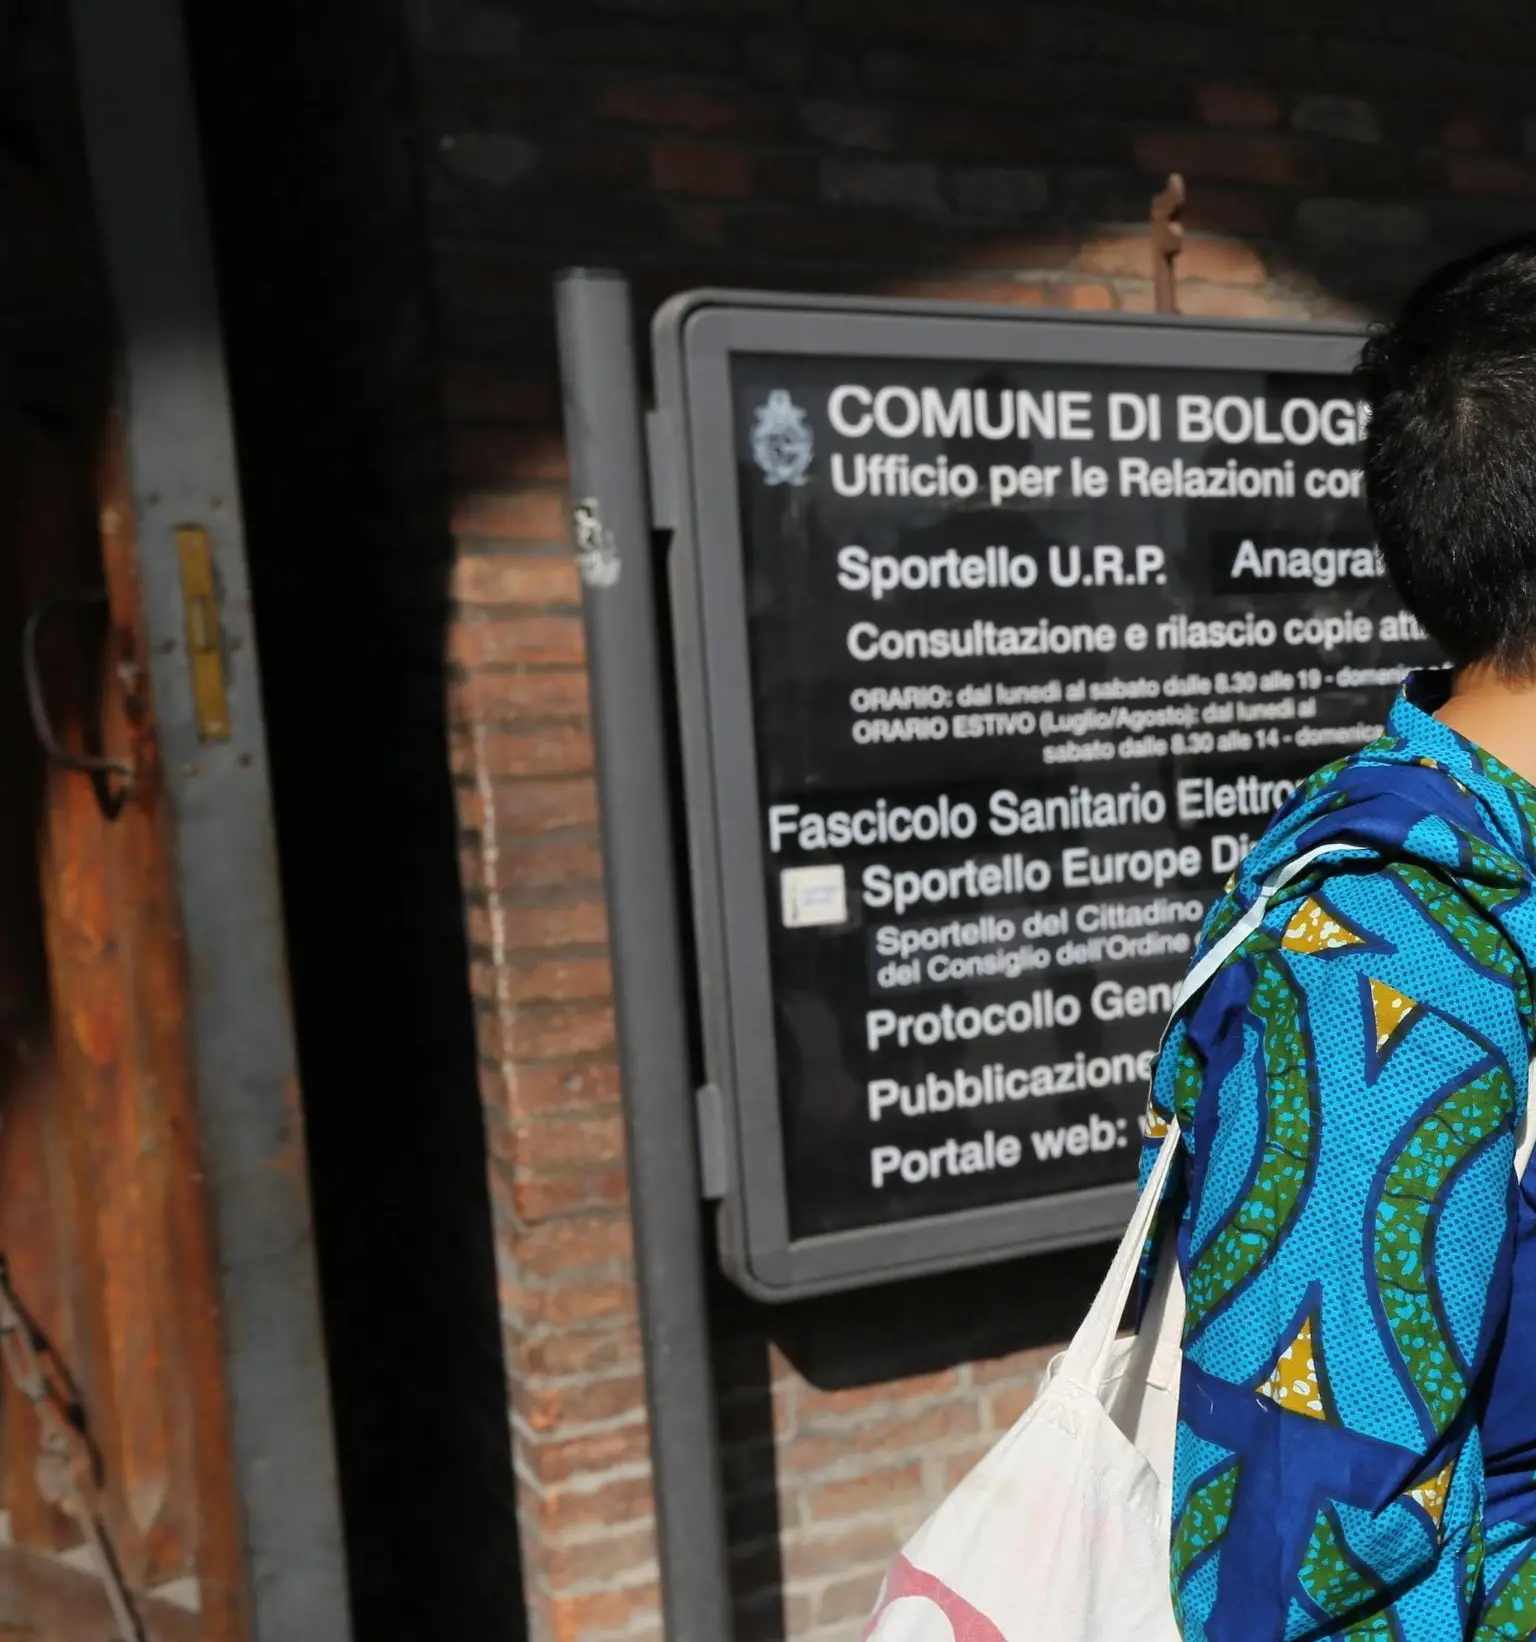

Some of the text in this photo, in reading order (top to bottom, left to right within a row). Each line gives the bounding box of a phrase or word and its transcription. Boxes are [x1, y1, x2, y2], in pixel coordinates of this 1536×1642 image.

[828, 386, 1092, 440] COMUNE
[1108, 394, 1158, 442] DI
[830, 455, 976, 497] Ufficio
[990, 462, 1060, 506] per
[1072, 456, 1106, 497] le
[1119, 459, 1294, 498] Relazioni
[837, 547, 1036, 598] Sportello
[1049, 546, 1166, 587] U.R.P.
[847, 609, 1429, 661] Consultazione e rilascio copie att
[850, 685, 952, 712] ORARIO:
[956, 683, 992, 707] dal
[1065, 678, 1085, 702] al
[1089, 677, 1160, 700] sabato
[1163, 674, 1212, 697] dalle
[1214, 671, 1257, 694] 8.30
[1259, 670, 1294, 692] alle
[852, 715, 949, 744] ORARIO
[951, 711, 1036, 738] ESTIVO
[1202, 701, 1234, 724] dal
[1297, 696, 1316, 718] al
[1042, 739, 1116, 764] sabato
[1118, 734, 1168, 759] dalle
[1170, 731, 1214, 755] 8.30
[1216, 729, 1253, 752] alle
[1254, 727, 1279, 748] 14
[769, 775, 1304, 852] Fascicolo Sanitario Elettro
[863, 854, 1051, 913] Sportello
[1063, 842, 1201, 889] Europe
[1211, 833, 1257, 873] Di
[876, 898, 1203, 958] Sportello del Cittadino
[877, 959, 920, 988] del
[927, 944, 1050, 982] Consiglio
[1056, 931, 1190, 966] dell'Ordine
[867, 989, 1079, 1051] Protocollo
[867, 1050, 1151, 1121] Pubblicazione
[871, 1131, 1022, 1188] Portale
[1031, 1114, 1127, 1159] web:
